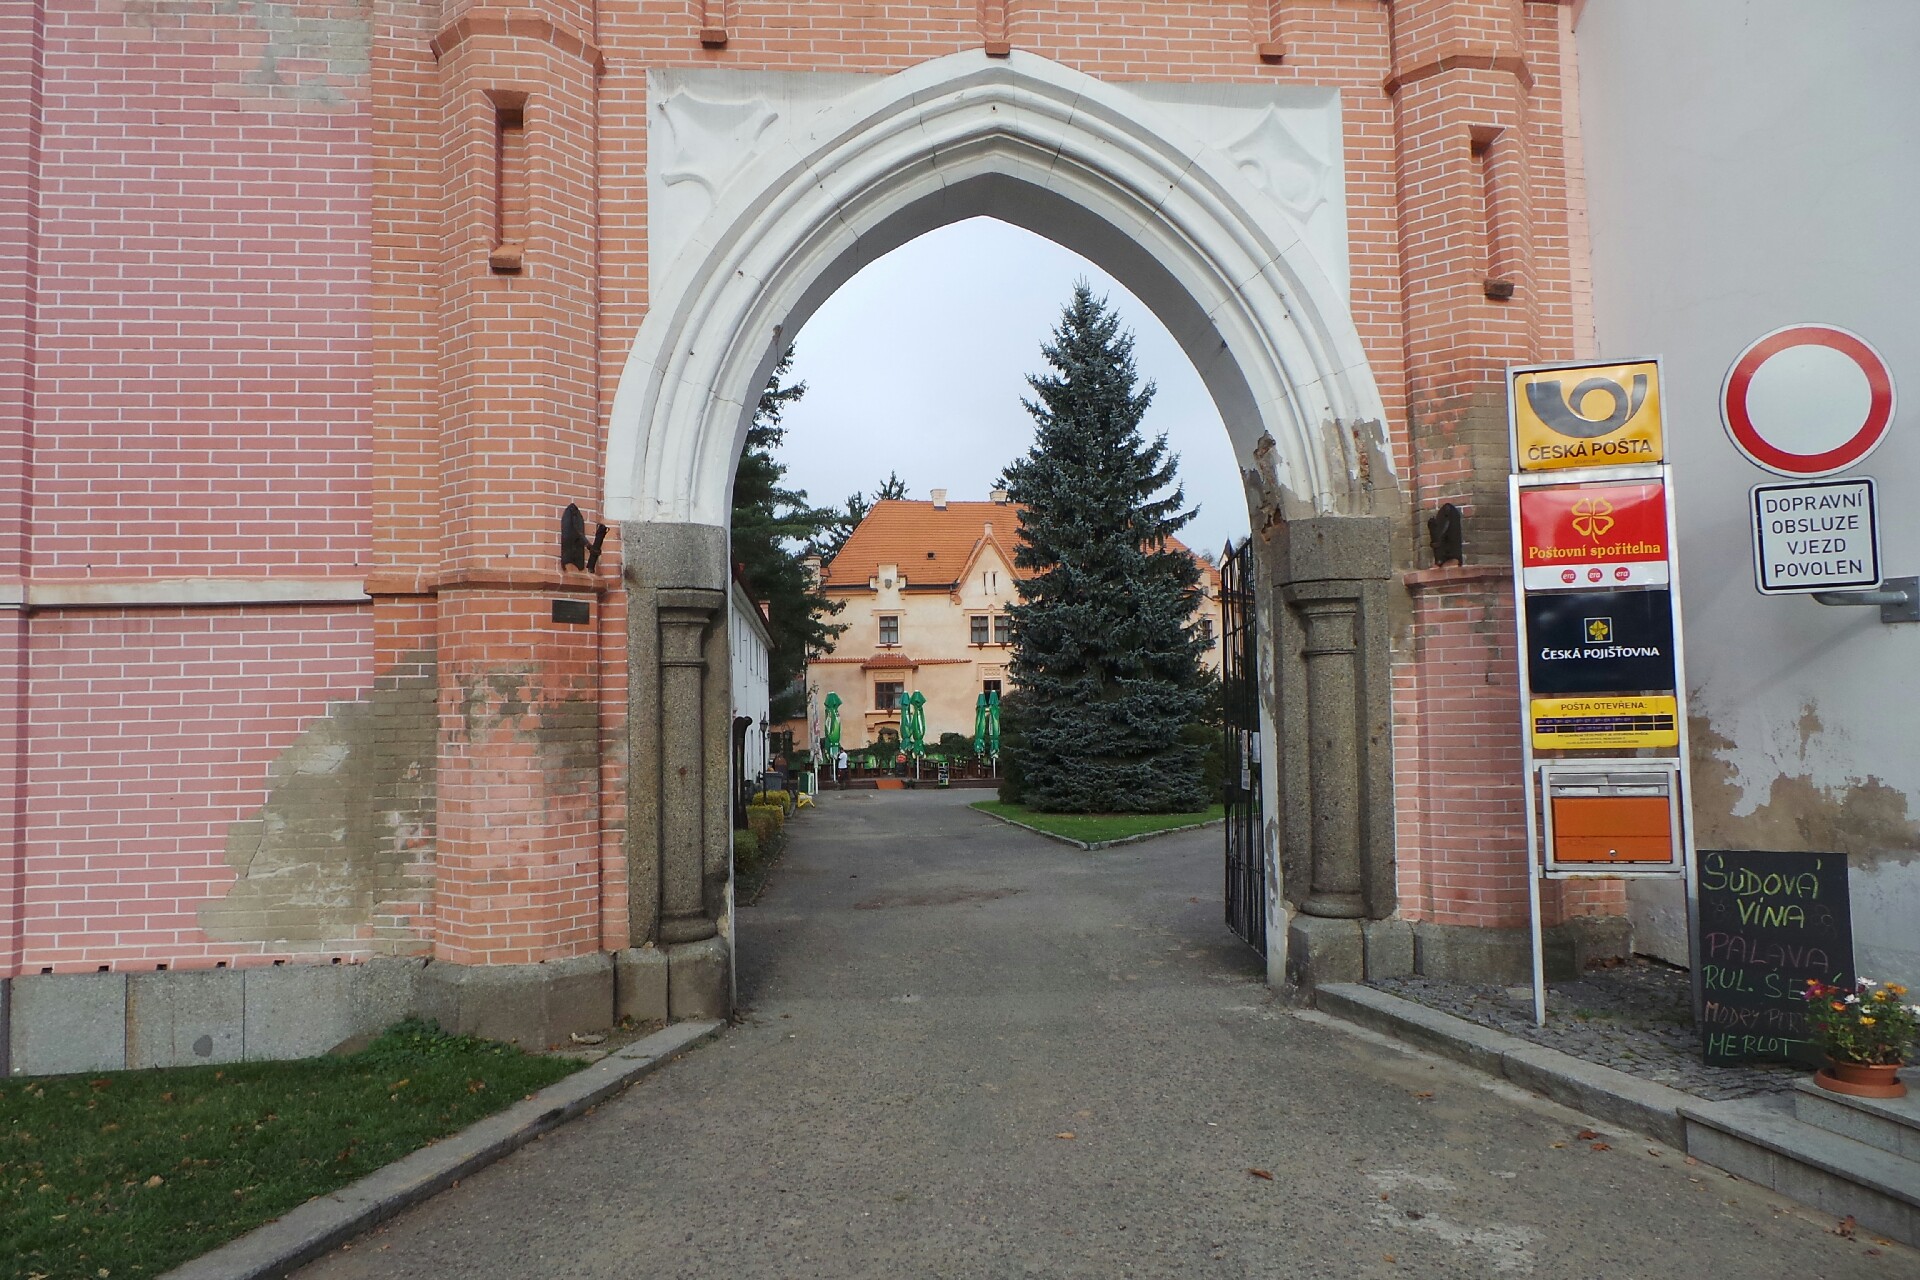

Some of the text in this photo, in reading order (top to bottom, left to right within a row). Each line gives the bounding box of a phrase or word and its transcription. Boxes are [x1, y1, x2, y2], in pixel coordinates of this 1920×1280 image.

[1528, 438, 1652, 460] ČESKÁ POŠTA
[1766, 489, 1863, 513] DOPRAVNÍ
[1772, 515, 1859, 534] OBSLUZE
[1529, 541, 1661, 559] Poštovní spořitelna
[1787, 538, 1846, 555] VJEZD
[1775, 559, 1862, 578] POVOLEN
[1541, 646, 1660, 660] ČESKÁ POJIŠŤOVNA
[1561, 702, 1591, 711] POŠTA
[1708, 1033, 1815, 1057] MERLOT
